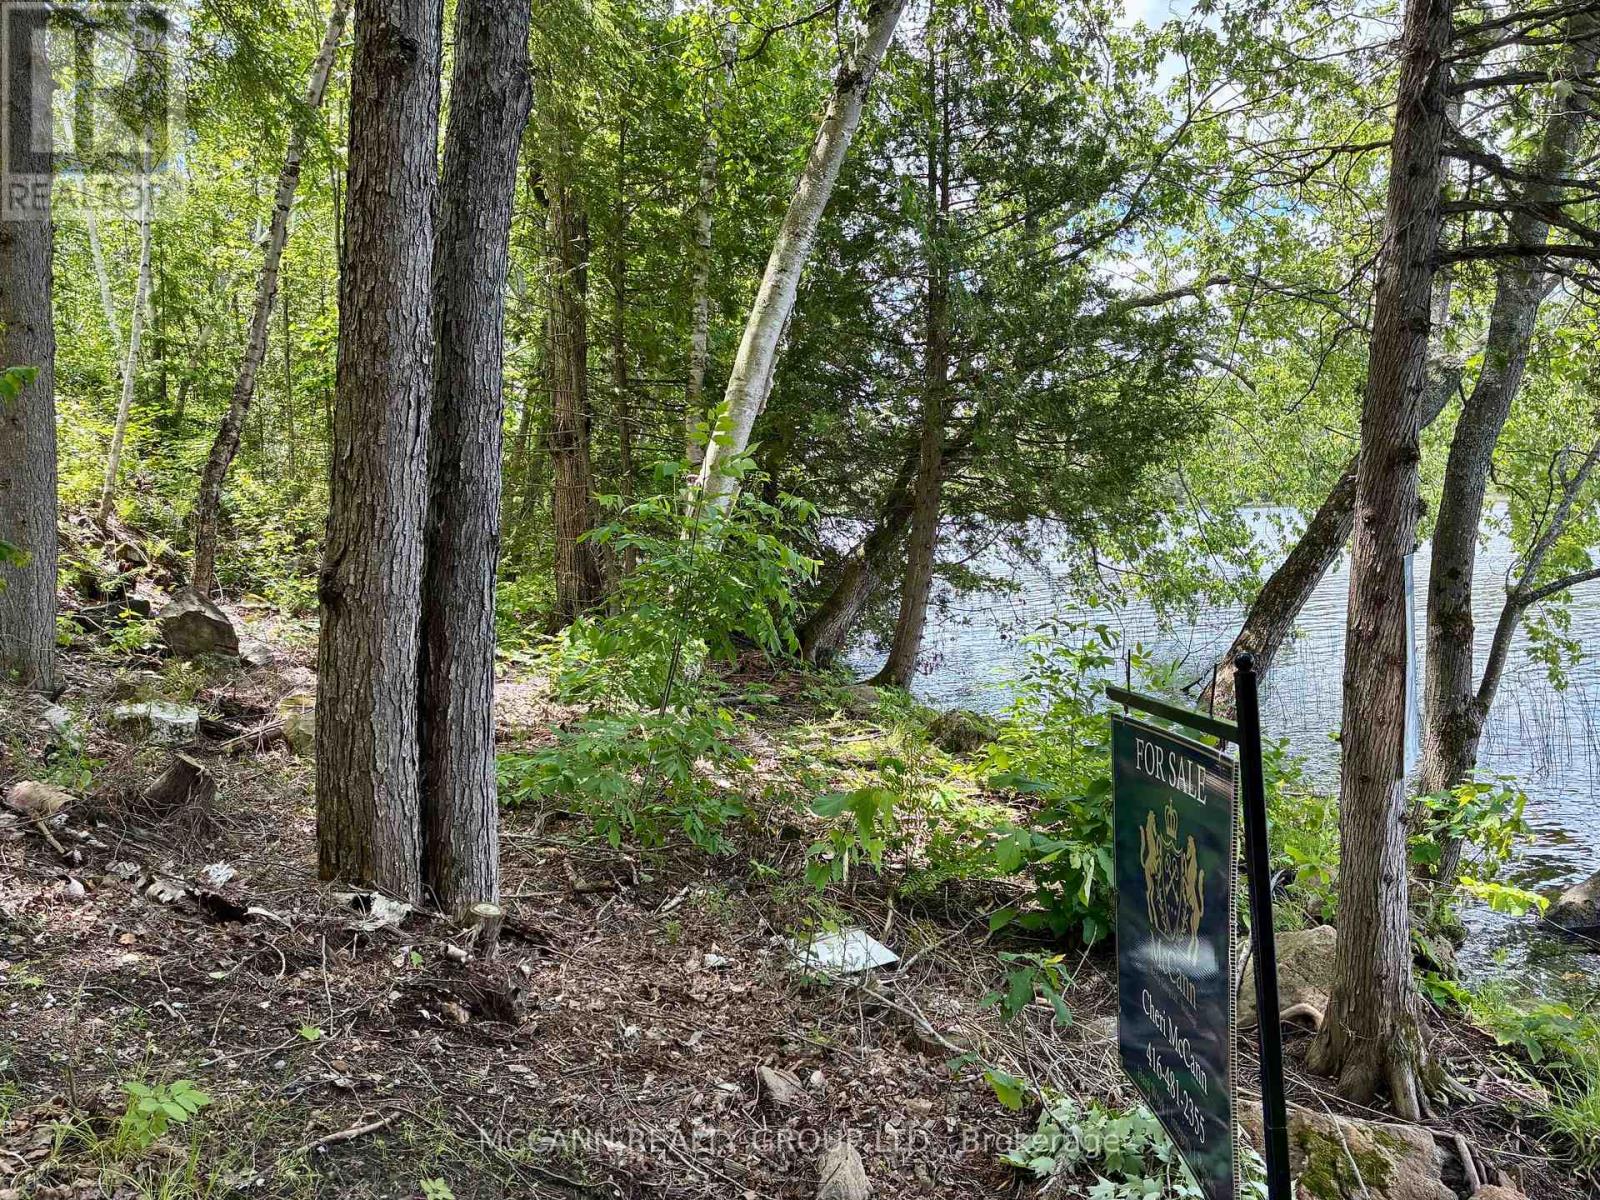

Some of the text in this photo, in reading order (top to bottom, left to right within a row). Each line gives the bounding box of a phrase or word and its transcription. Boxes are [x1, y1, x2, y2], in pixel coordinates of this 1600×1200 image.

[1135, 737, 1207, 805] FOR SALE
[1150, 938, 1197, 1012] McCann
[1142, 988, 1167, 1038] Cheri
[1168, 1016, 1207, 1095] McCann
[1146, 1041, 1206, 1145] 416-481-2355
